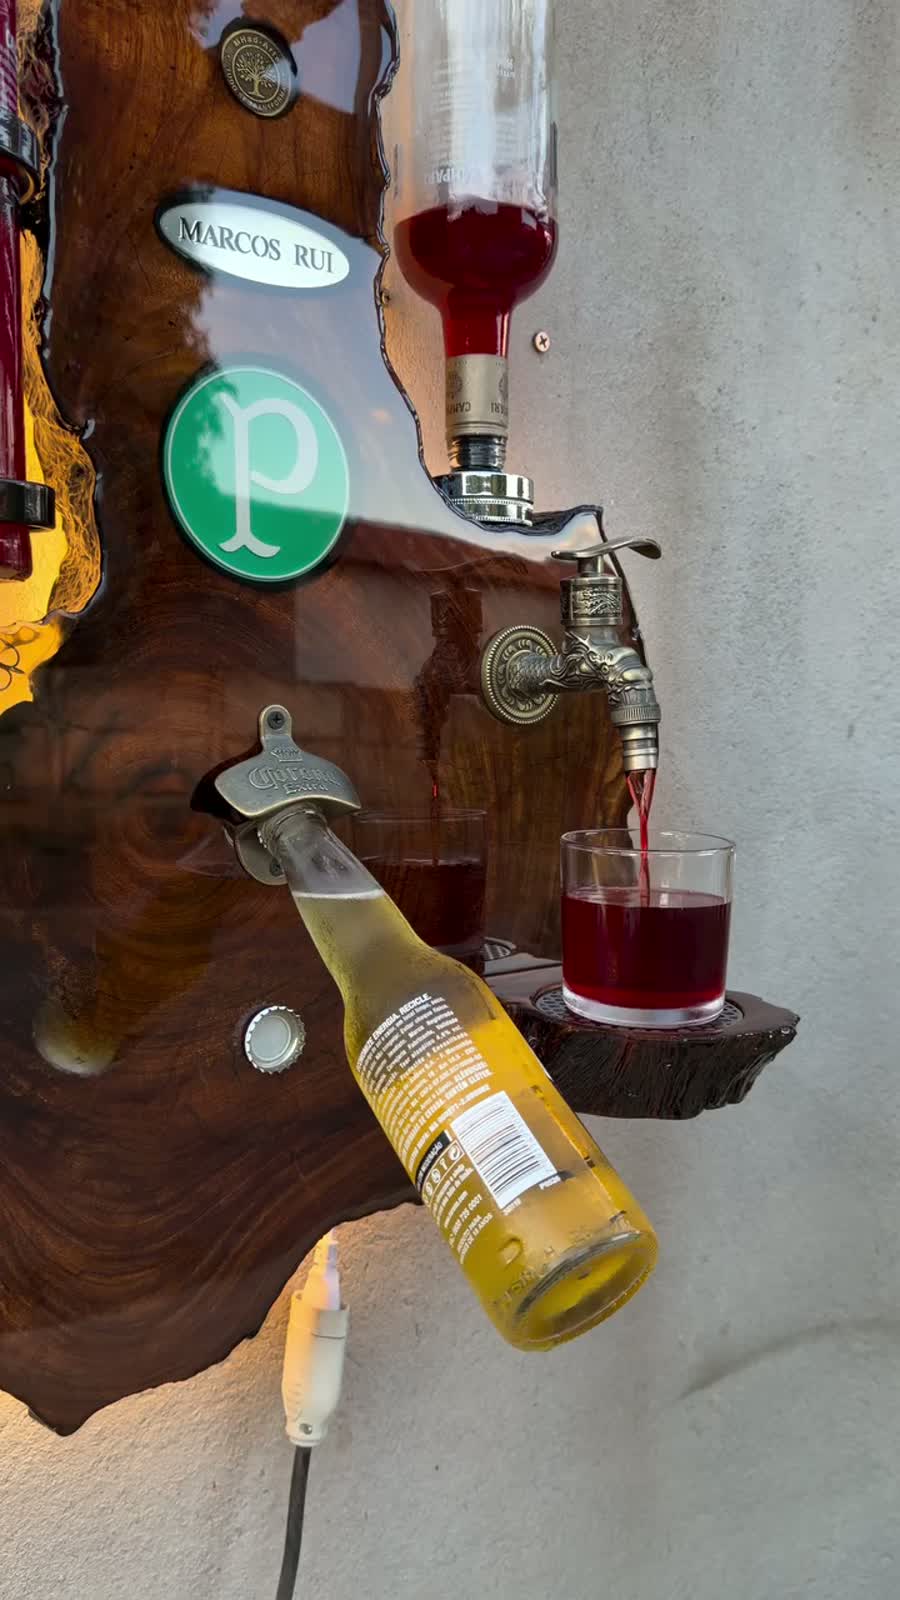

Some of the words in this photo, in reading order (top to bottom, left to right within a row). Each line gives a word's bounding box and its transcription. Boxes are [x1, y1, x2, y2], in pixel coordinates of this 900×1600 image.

[178, 216, 281, 261] MARCOS
[294, 244, 334, 273] RUI
[249, 766, 342, 791] Corona
[372, 1013, 400, 1040] ENERGIA.
[399, 993, 432, 1015] RECICLE.
